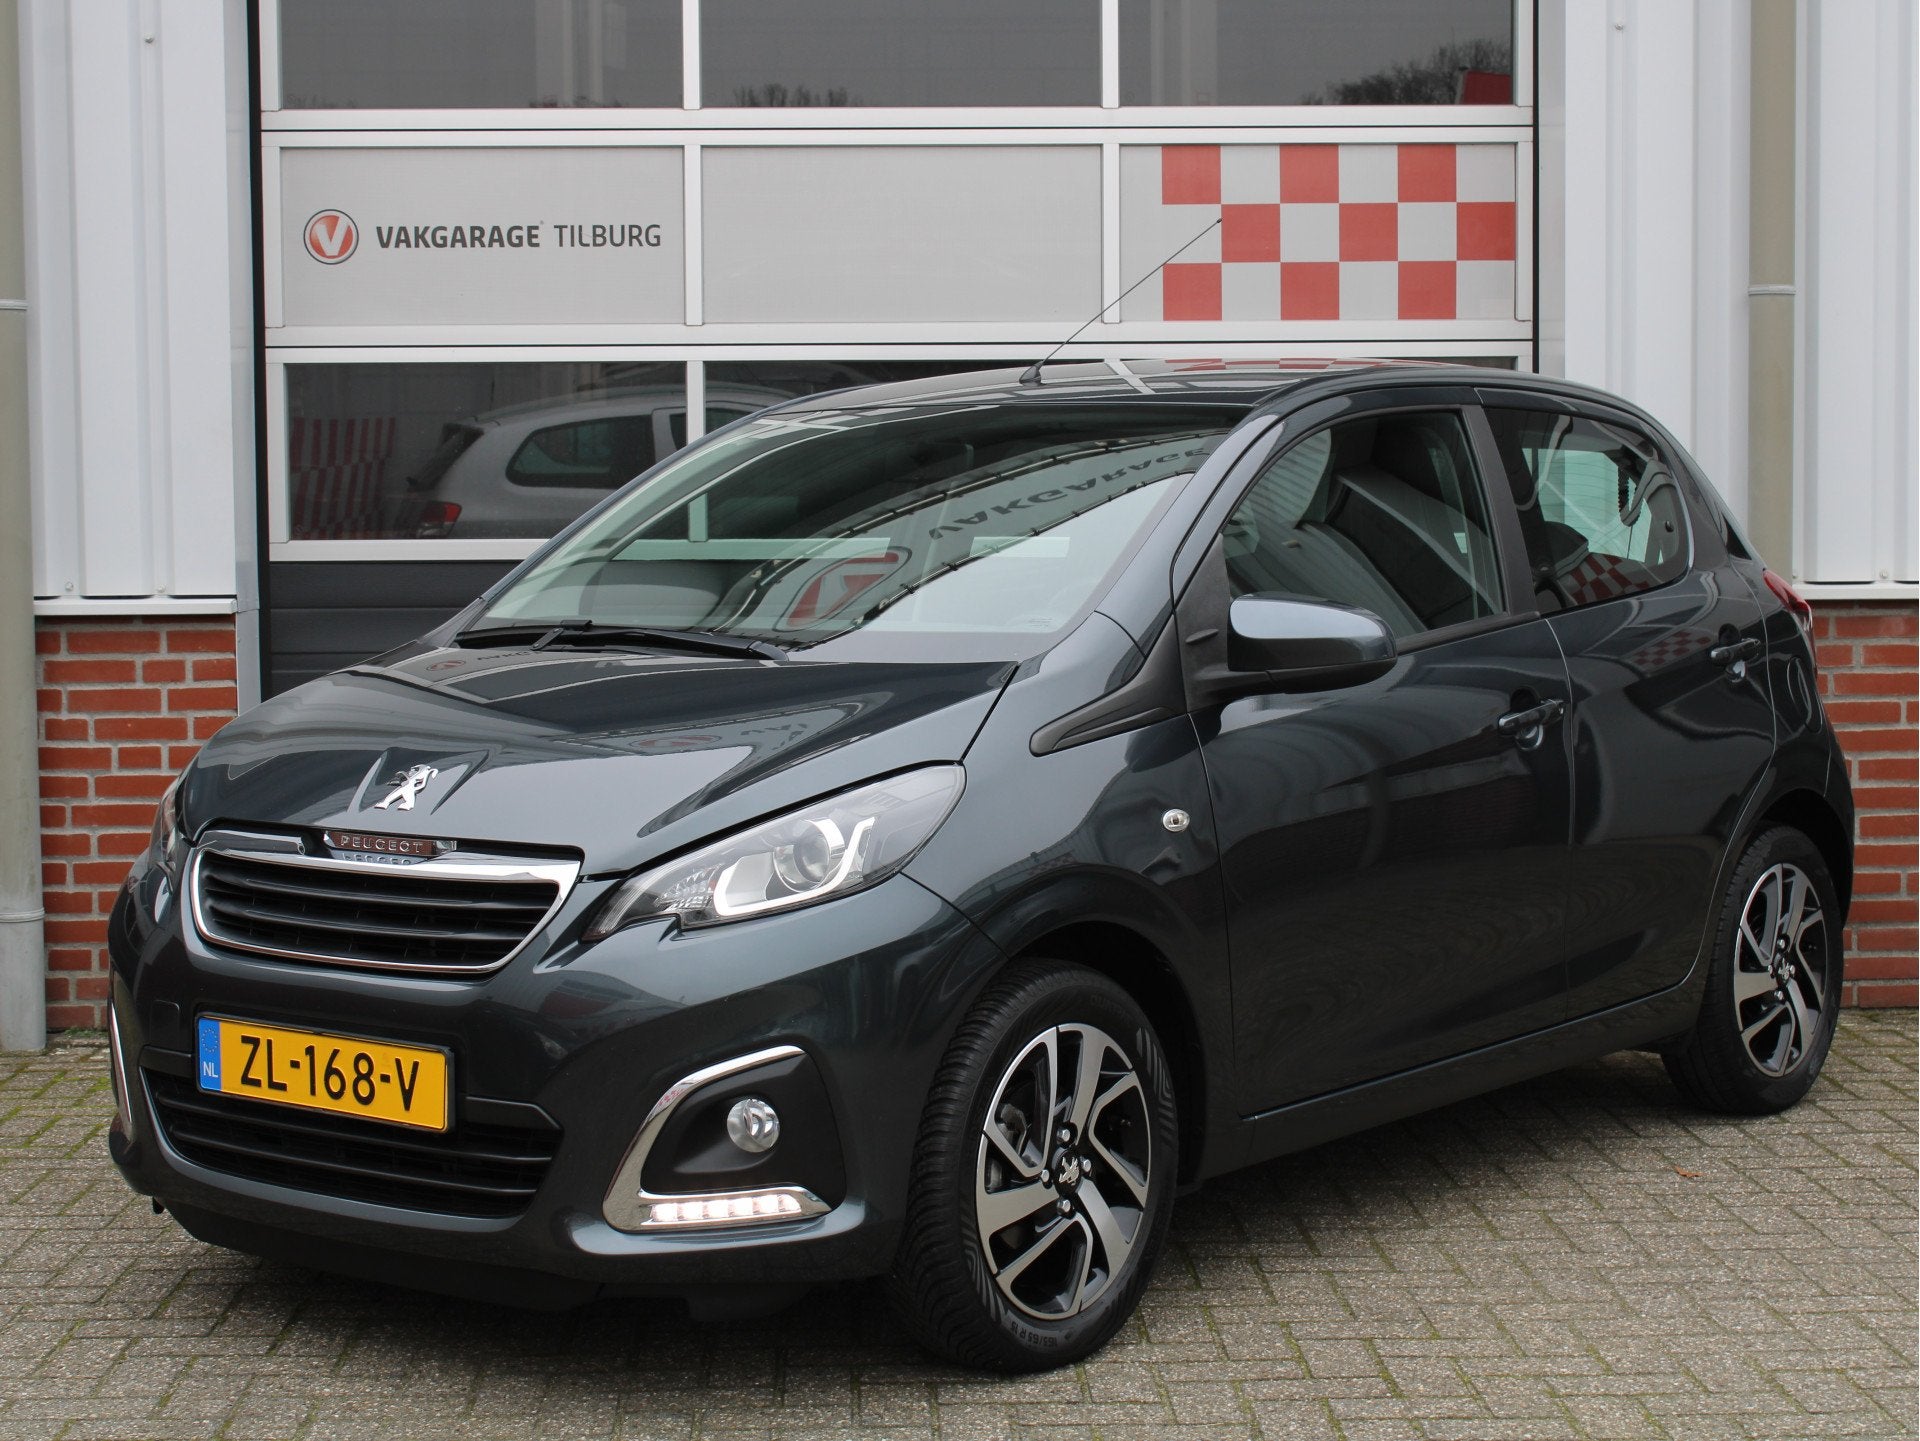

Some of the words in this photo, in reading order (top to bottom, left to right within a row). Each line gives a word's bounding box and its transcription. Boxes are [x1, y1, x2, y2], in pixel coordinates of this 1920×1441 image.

[376, 225, 540, 248] VAKGARAGE
[554, 224, 661, 247] TILBURG
[340, 835, 423, 853] PEUGEOT
[203, 1061, 218, 1078] NL
[240, 1035, 420, 1111] ZL-168-V
